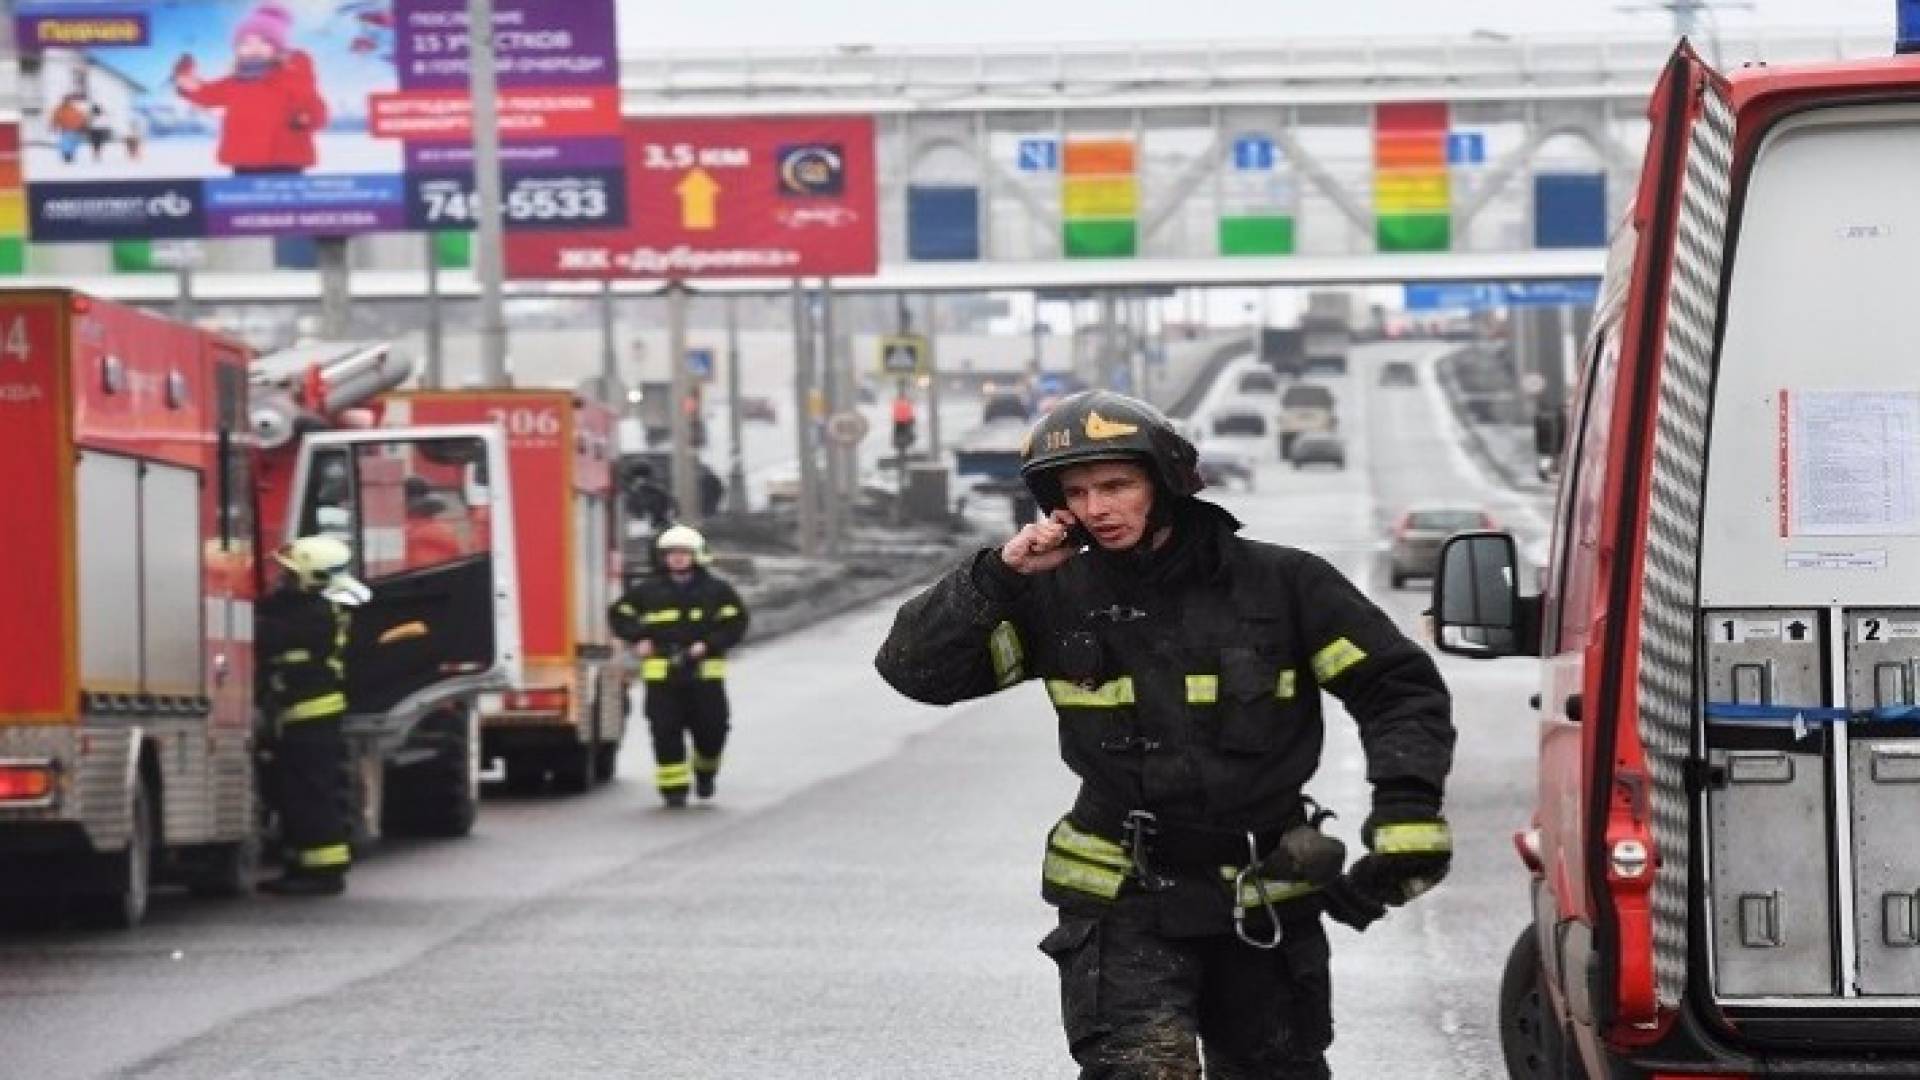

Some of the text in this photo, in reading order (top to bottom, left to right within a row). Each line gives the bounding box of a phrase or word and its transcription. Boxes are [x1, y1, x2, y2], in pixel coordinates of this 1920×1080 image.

[413, 34, 441, 52] 15
[643, 143, 749, 171] 3,5 км
[558, 248, 609, 270] ЖК
[1722, 620, 1735, 641] 1
[1864, 620, 1881, 641] 2
